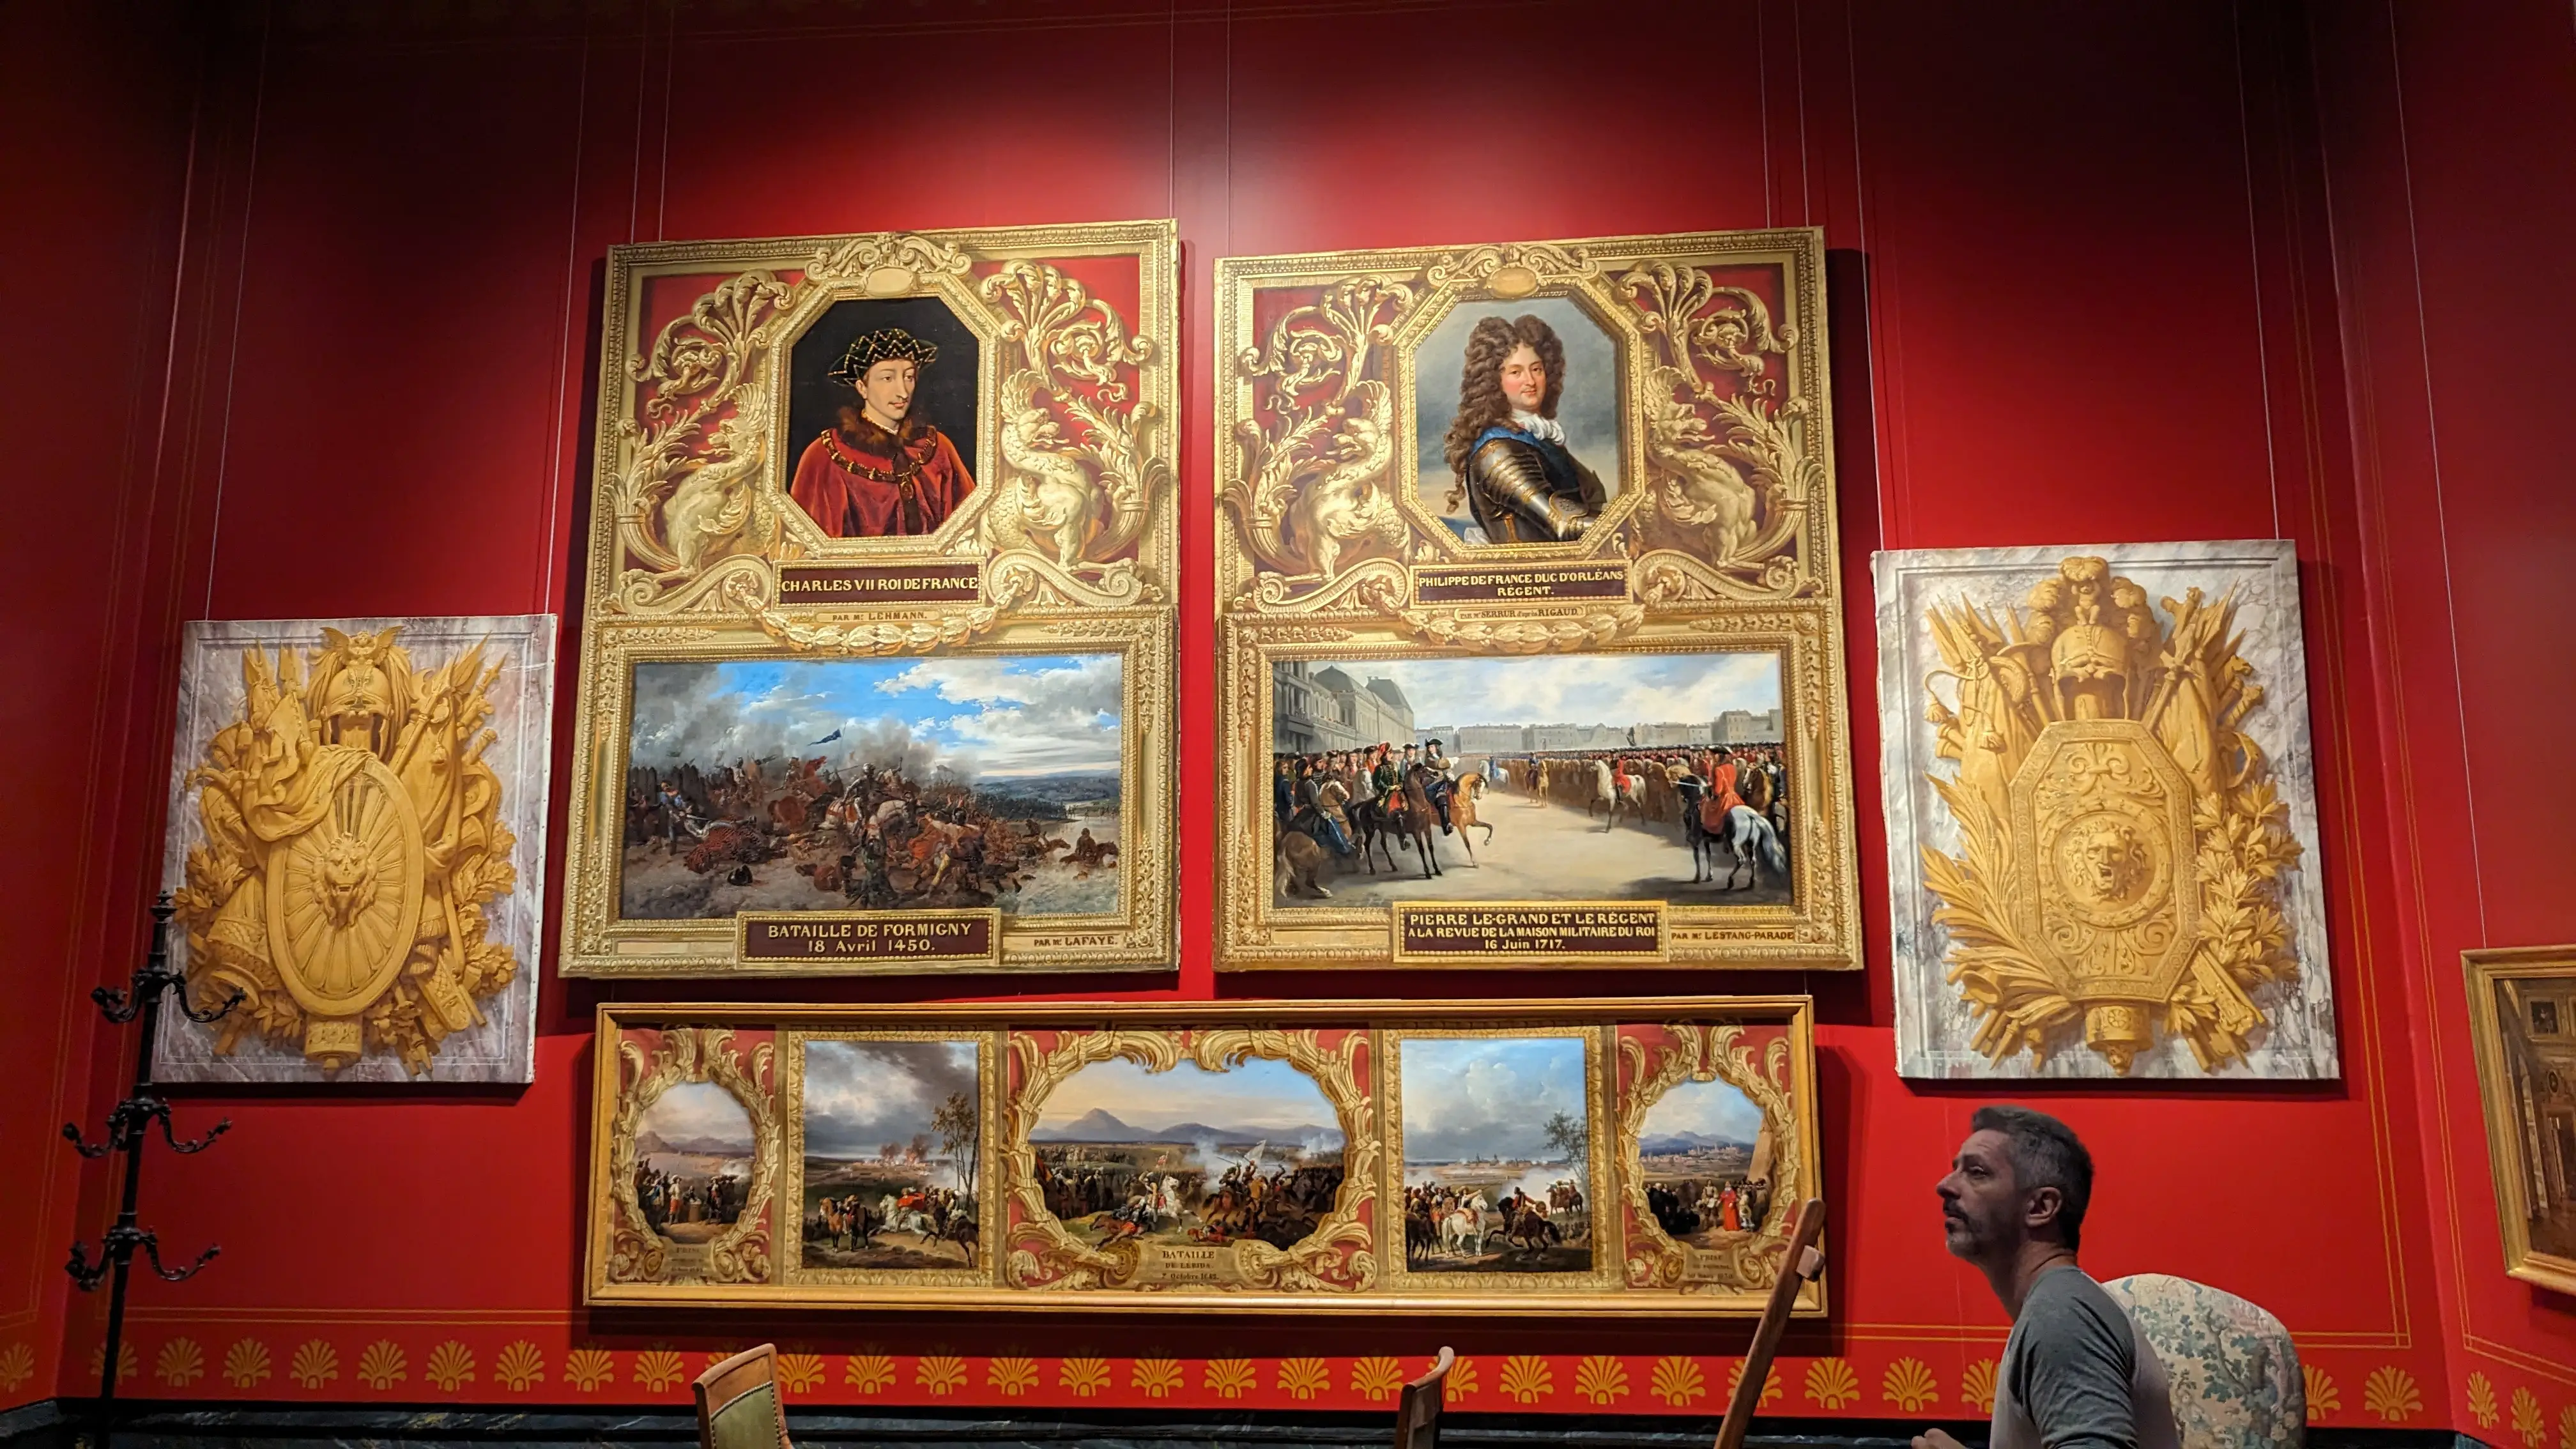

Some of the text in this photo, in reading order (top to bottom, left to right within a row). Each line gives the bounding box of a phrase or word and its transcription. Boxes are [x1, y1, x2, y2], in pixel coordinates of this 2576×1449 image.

[1419, 569, 1624, 587] PHILIPPE DE FRANCE DUC D'ORLÉANS
[781, 577, 978, 592] CHARLES VII ROI DE FRANCE
[1497, 584, 1554, 596] RÉGENT.
[869, 611, 927, 621] LEHMANN.
[1482, 610, 1516, 618] SERRUR
[1410, 911, 1655, 925] PIERRE LE-GRAND ET LE RÉGENT
[768, 923, 972, 938] BATAILLE DE FORMIGNY
[1408, 926, 1655, 938] A LA REVUE DE LA MAISON MILITAIRE DU ROI
[808, 939, 936, 953] 18 Avril 1450.
[1065, 935, 1118, 946] LAFAYE.
[1485, 939, 1566, 949] 16 Juin 1717.
[1162, 1250, 1215, 1259] BATAILLE
